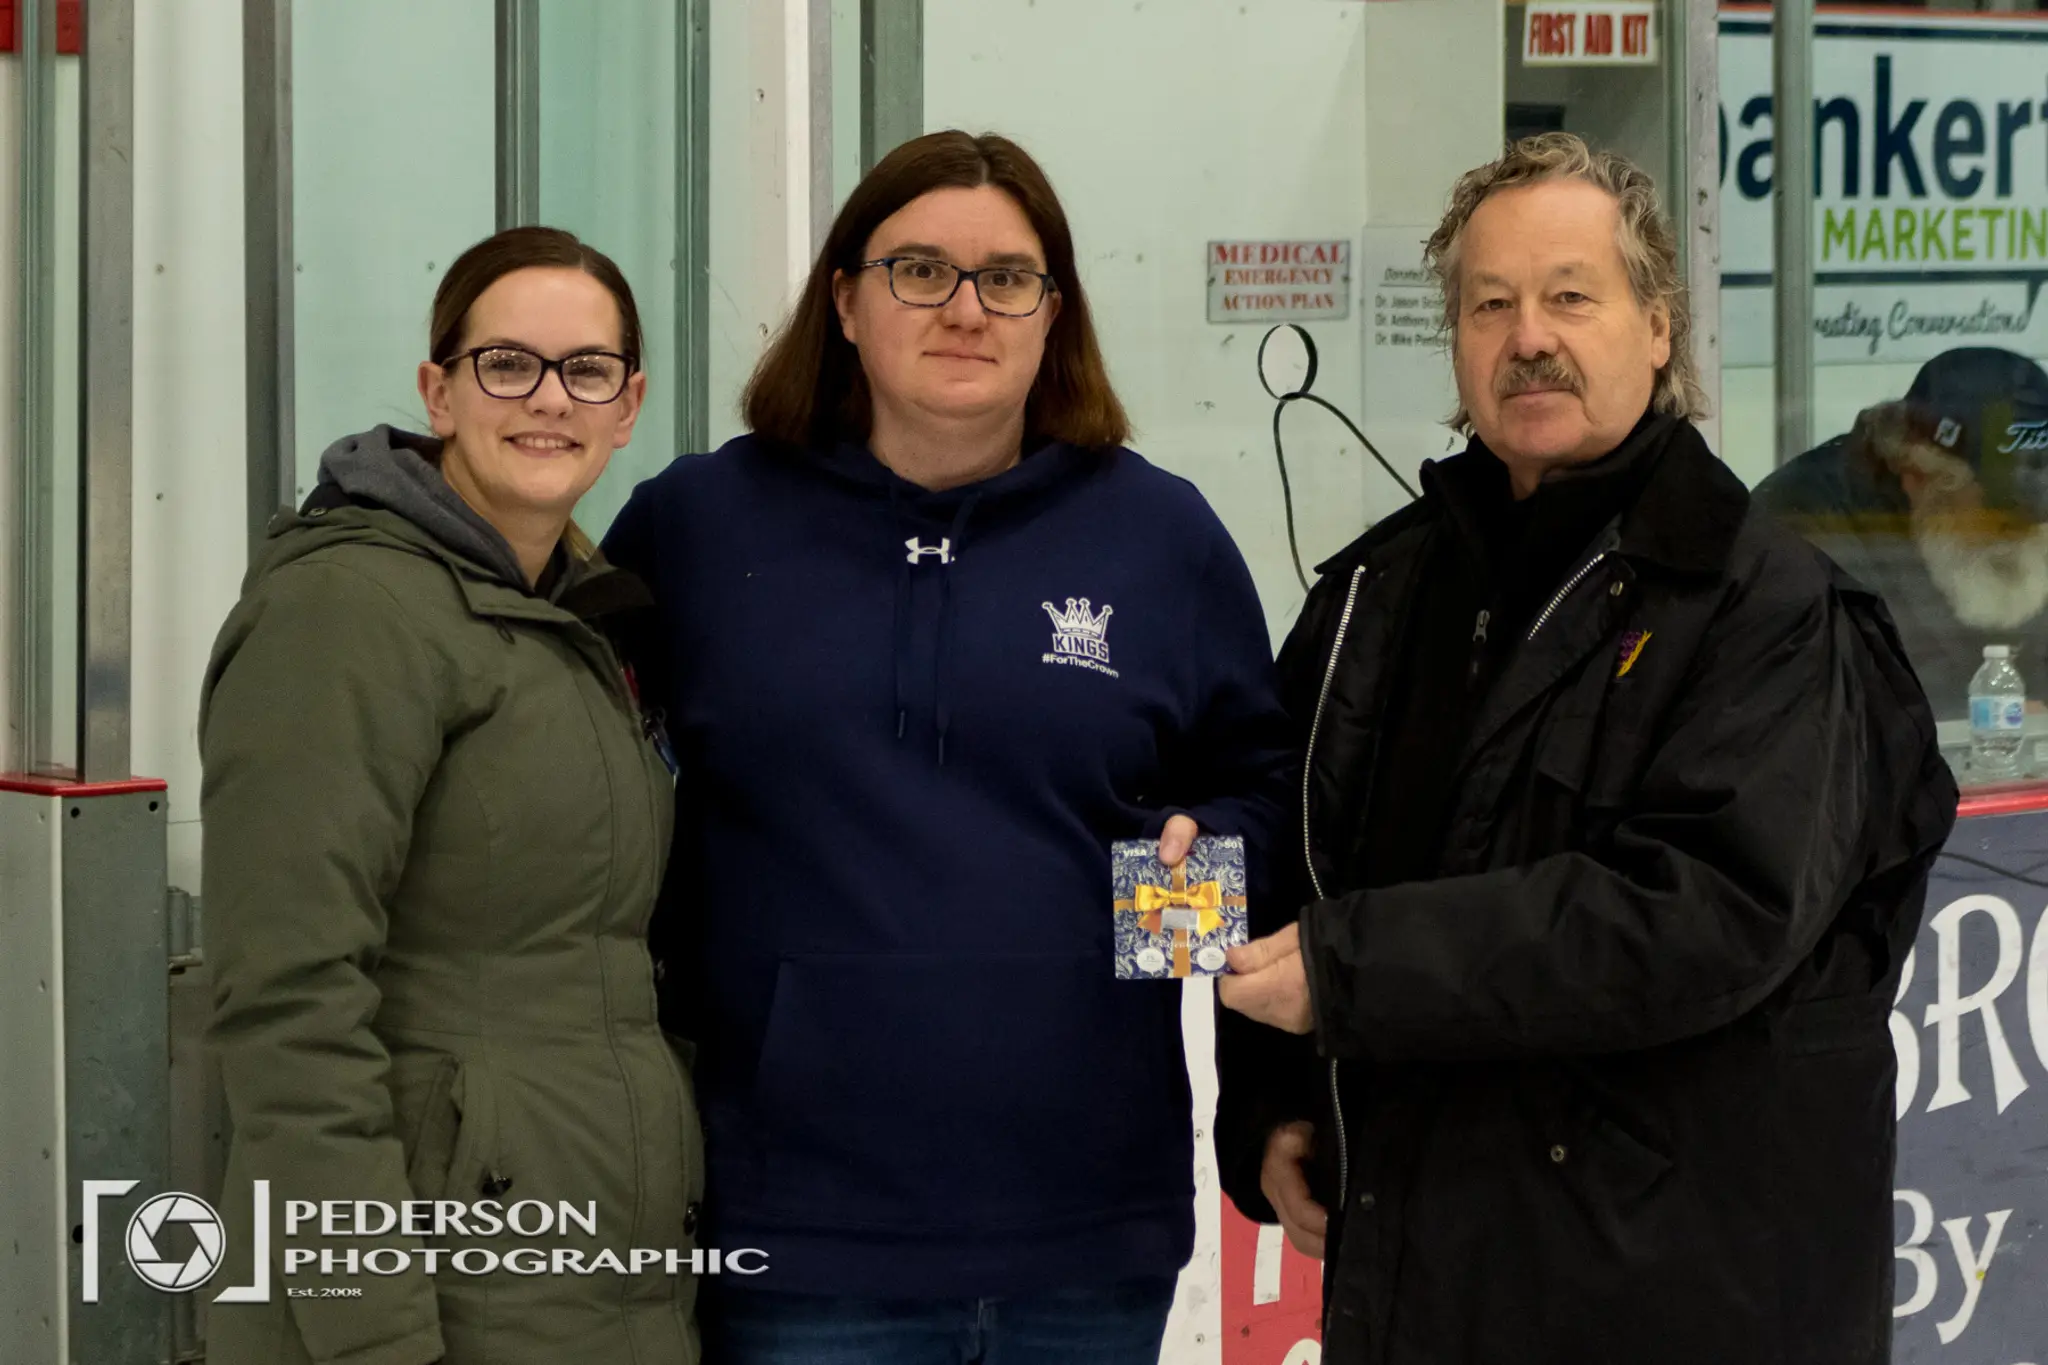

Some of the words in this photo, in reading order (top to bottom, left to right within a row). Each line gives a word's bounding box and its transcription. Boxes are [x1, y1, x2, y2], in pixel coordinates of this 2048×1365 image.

[1528, 12, 1576, 56] FIRST
[1584, 13, 1612, 55] AID
[1621, 13, 1648, 56] KIT
[1719, 55, 2048, 201] anker
[1213, 244, 1344, 264] MEDICAL
[1224, 268, 1333, 285] EMERGENCY
[1222, 293, 1286, 310] ACTION
[1291, 293, 1334, 310] PLAN
[1053, 633, 1109, 663] KINGS
[1042, 653, 1119, 678] #ForTheCrown
